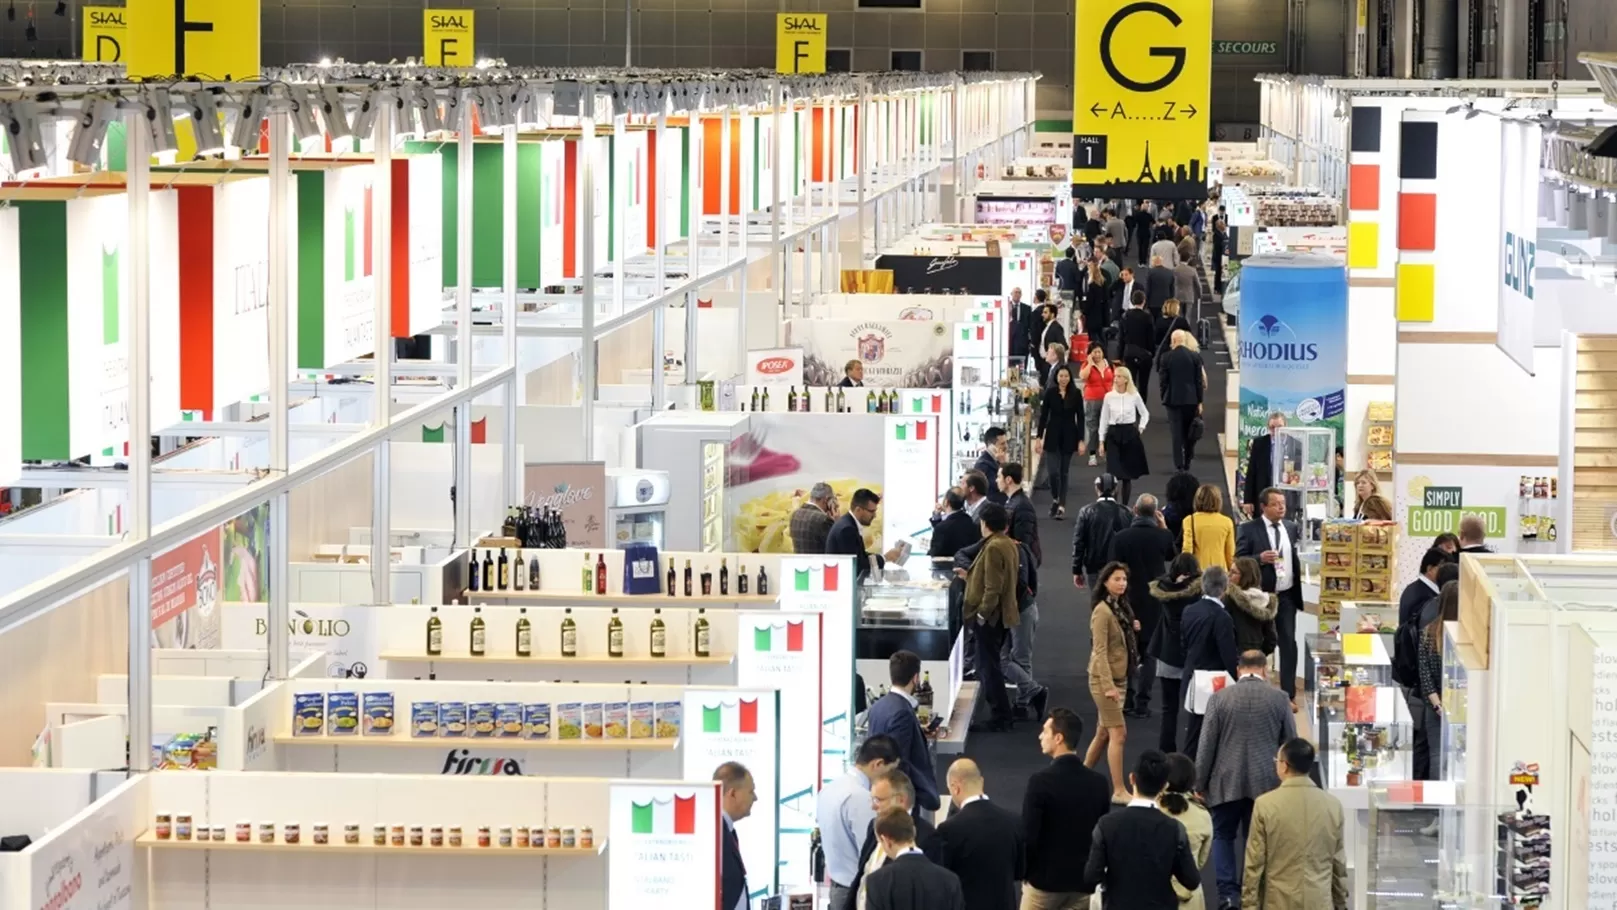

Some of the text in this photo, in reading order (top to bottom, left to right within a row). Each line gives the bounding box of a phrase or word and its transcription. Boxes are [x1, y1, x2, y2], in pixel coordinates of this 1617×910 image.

[90, 12, 127, 25] SIAL
[431, 16, 468, 29] SIAL
[784, 17, 821, 30] SIAL
[97, 35, 121, 62] D
[1100, 2, 1186, 92] G
[1218, 42, 1276, 53] SECOURS
[795, 41, 809, 73] F
[1080, 136, 1099, 144] HALL
[1086, 146, 1092, 165] 1
[1426, 491, 1460, 506] SIMPLY
[1412, 510, 1453, 532] GOOD
[256, 617, 350, 636] BNOLIO
